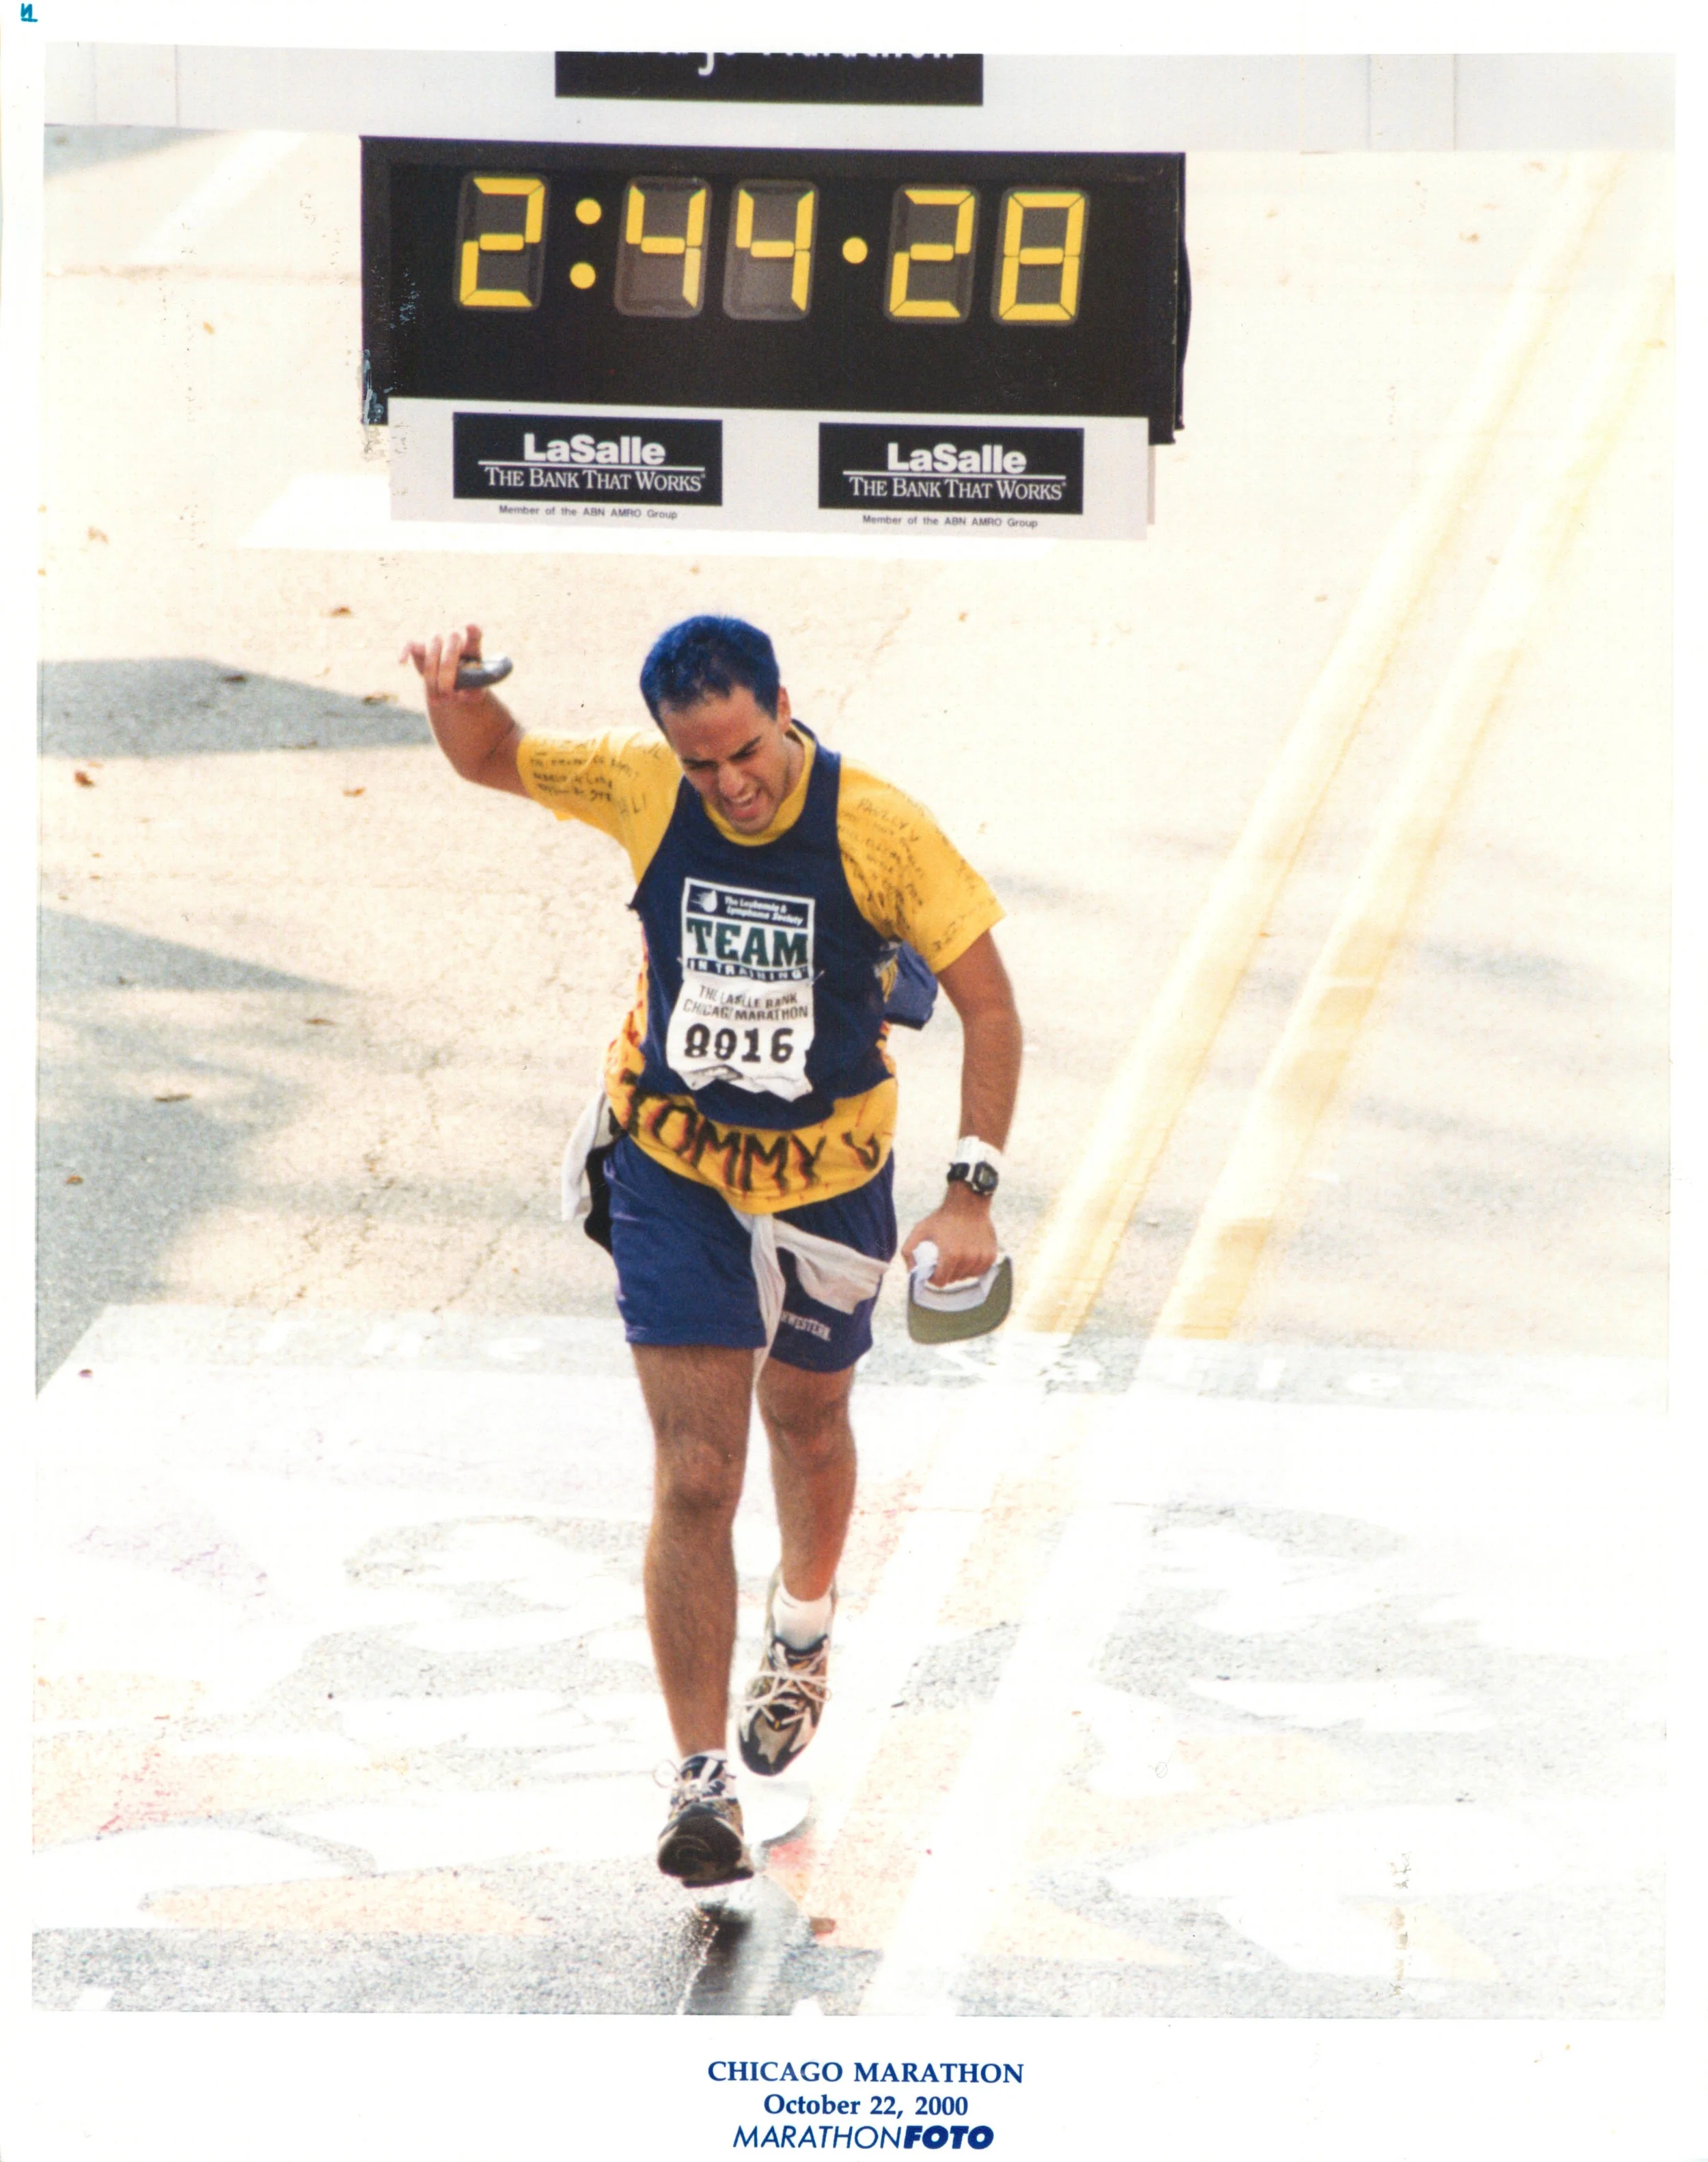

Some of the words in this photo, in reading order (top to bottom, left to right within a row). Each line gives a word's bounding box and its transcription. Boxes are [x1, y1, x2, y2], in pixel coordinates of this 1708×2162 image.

[524, 433, 666, 465] LaSalle
[888, 441, 1027, 474] LaSalle
[485, 467, 524, 487] THE
[529, 468, 579, 489] BANK
[581, 469, 631, 490] THAT
[849, 476, 887, 497] THE
[892, 478, 941, 498] BANK
[944, 479, 993, 500] THAT
[499, 505, 539, 515] Member
[545, 506, 555, 515] of
[561, 506, 577, 517] the
[583, 507, 605, 517] ABN
[611, 508, 642, 518] AMRO
[647, 510, 678, 520] Group
[863, 515, 902, 525] Member
[907, 516, 918, 525] of
[923, 516, 939, 526] the
[944, 517, 967, 526] ABN
[972, 518, 1002, 528] AMRO
[1008, 518, 1038, 529] Group
[686, 916, 808, 967] TEAM
[689, 958, 708, 971] IN
[765, 992, 797, 1009] BANK
[734, 1005, 808, 1021] MARATHON
